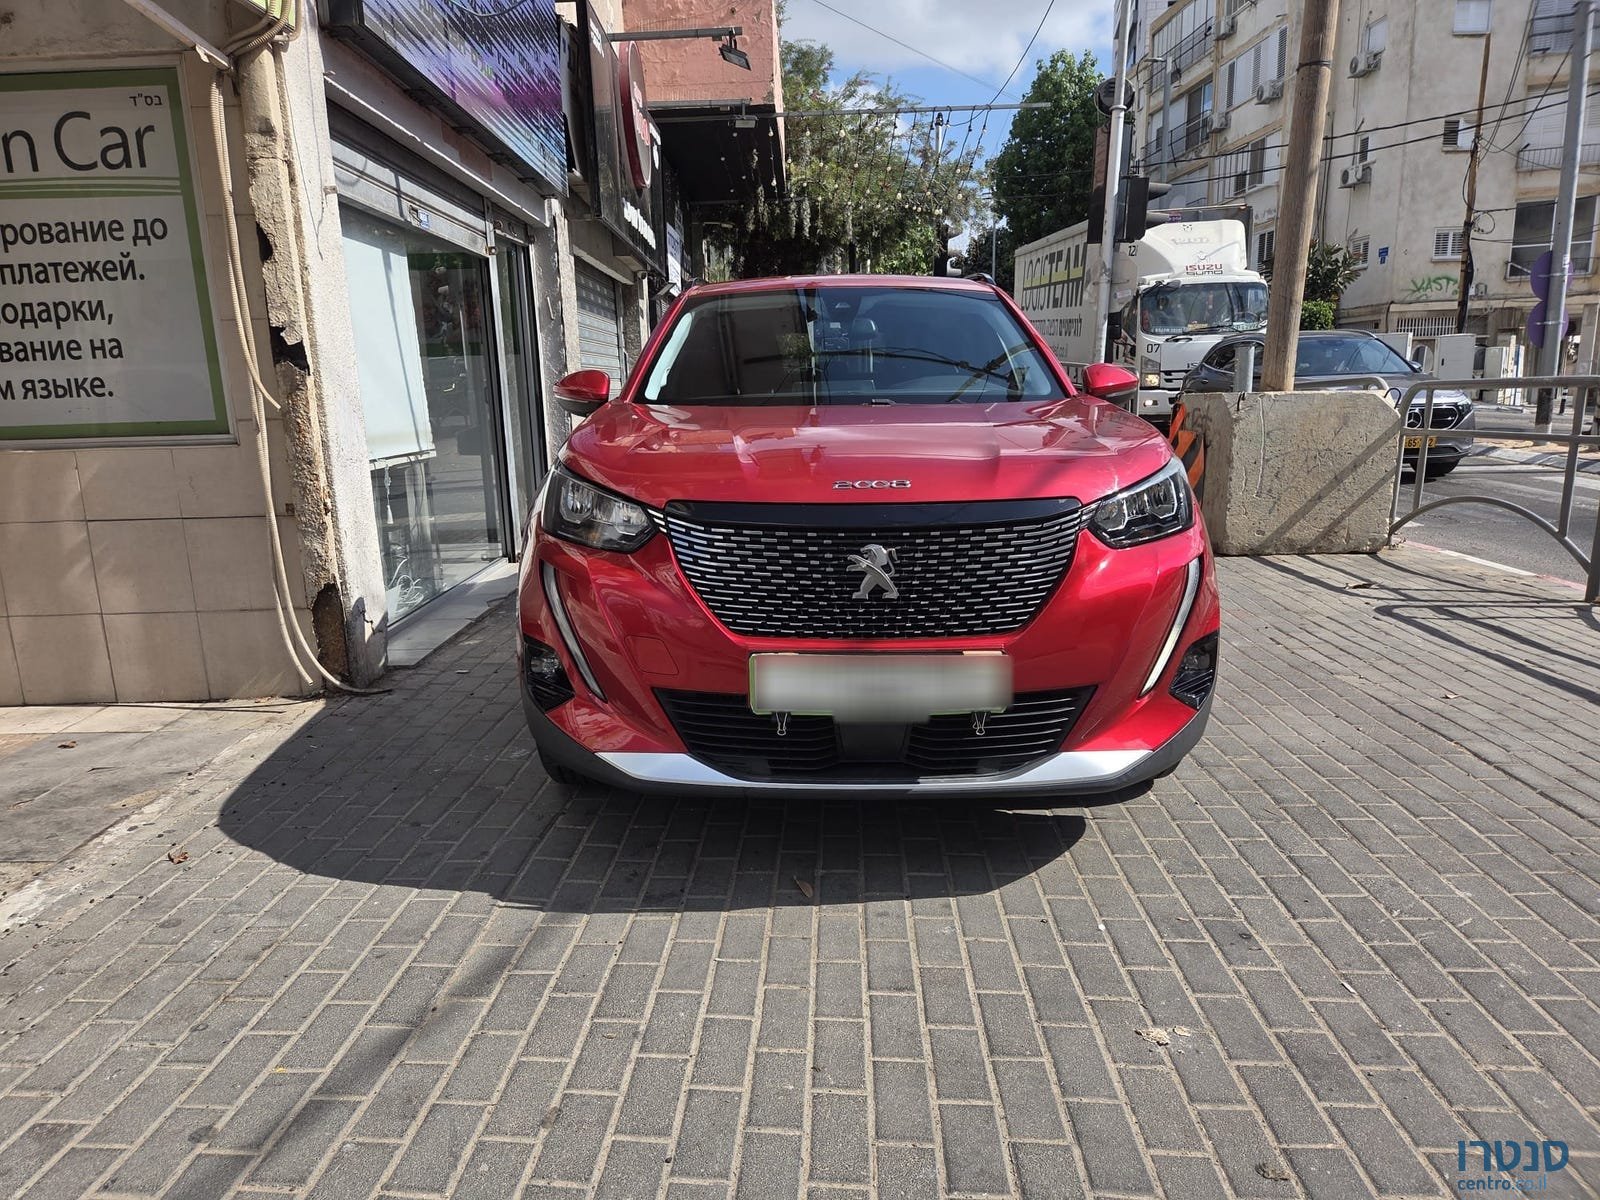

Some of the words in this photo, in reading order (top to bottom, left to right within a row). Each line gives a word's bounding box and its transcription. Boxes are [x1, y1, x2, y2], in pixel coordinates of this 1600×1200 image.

[128, 93, 164, 107] בס"ד
[53, 110, 156, 172] Car
[0, 219, 125, 253] рование
[131, 217, 168, 247] до
[0, 251, 146, 286] платежей.
[1185, 263, 1223, 271] ISUZU
[1, 300, 114, 330] одарки,
[0, 338, 83, 363] вание
[89, 337, 124, 360] на
[21, 376, 115, 400] языке.
[832, 479, 912, 490] 2008
